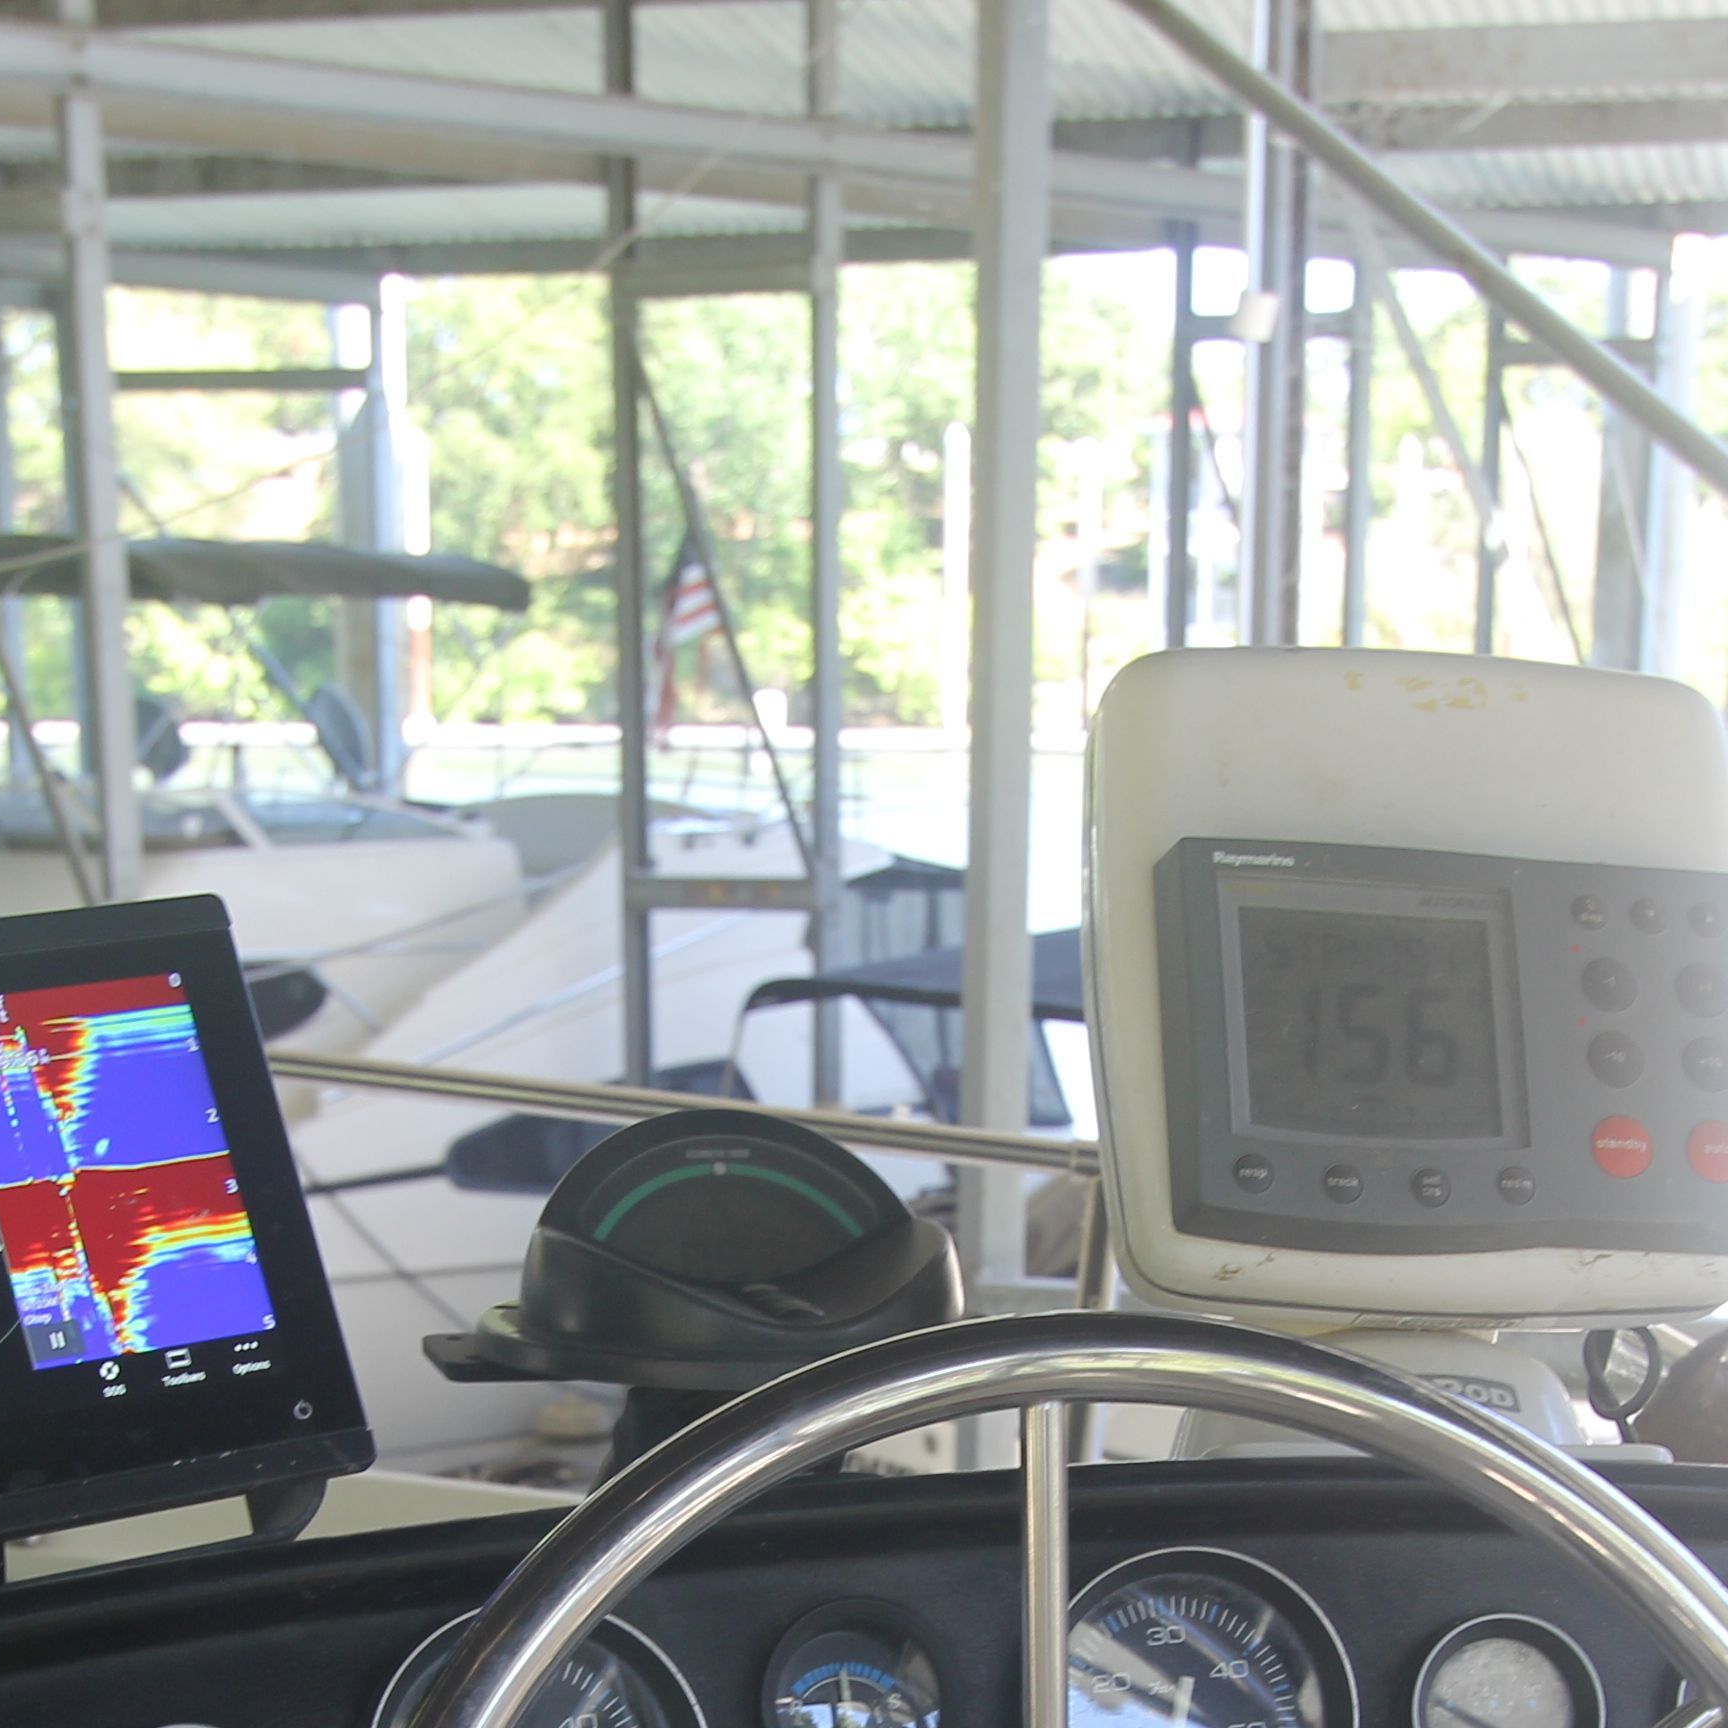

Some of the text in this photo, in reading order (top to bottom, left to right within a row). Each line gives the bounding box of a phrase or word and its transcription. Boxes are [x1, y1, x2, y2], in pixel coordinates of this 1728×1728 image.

[224, 1178, 240, 1195] 3
[1145, 1624, 1187, 1646] 30
[1208, 1659, 1250, 1680] 40
[1090, 1672, 1132, 1694] 20
